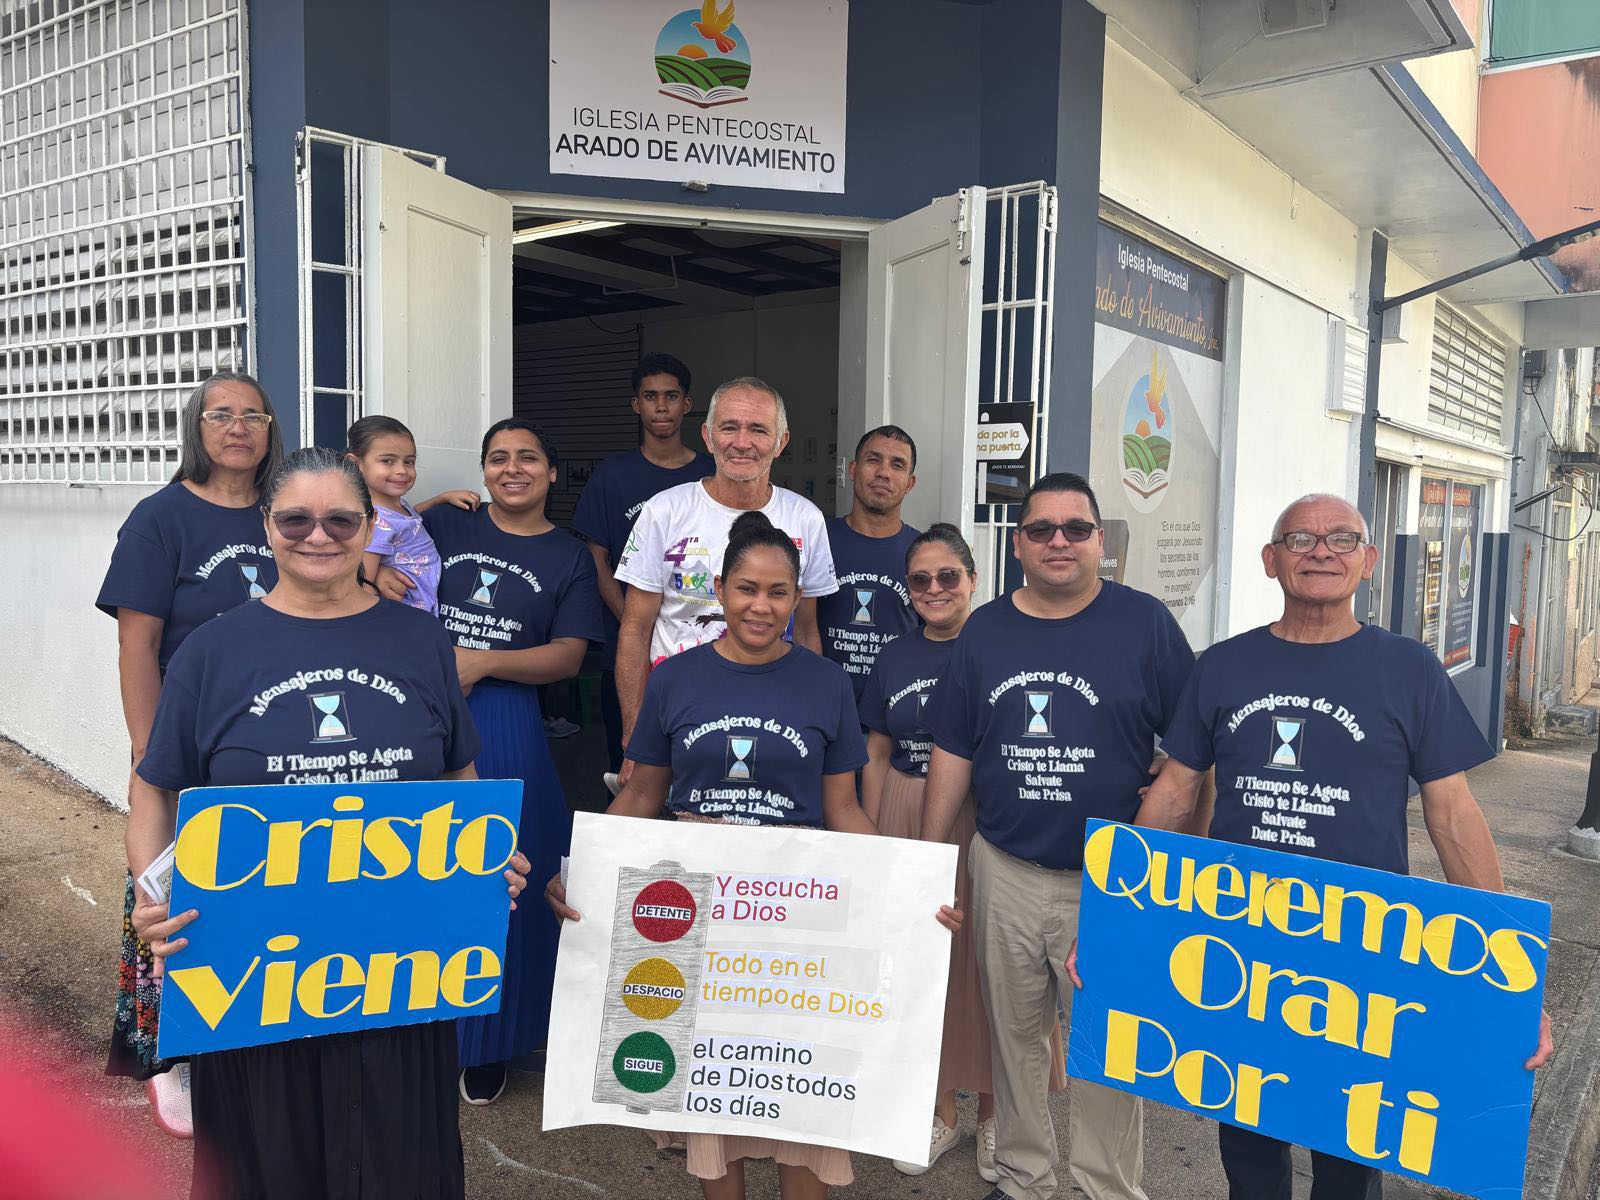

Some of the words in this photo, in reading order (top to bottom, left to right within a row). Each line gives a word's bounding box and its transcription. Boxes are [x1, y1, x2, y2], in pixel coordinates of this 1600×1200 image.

[573, 107, 660, 132] IGLESIA
[667, 114, 821, 145] PENTECOSTAL
[556, 133, 640, 158] ARADO
[648, 140, 678, 162] DE
[684, 142, 835, 173] AVIVAMIENTO
[1118, 243, 1145, 275] Iglesia
[1146, 256, 1189, 291] Pentecostal
[1119, 281, 1135, 320] de
[989, 442, 1023, 454] puerta.
[992, 431, 1008, 442] por
[1010, 429, 1020, 438] la
[195, 544, 256, 579] Mensajeros
[258, 545, 274, 558] de
[442, 552, 508, 570] Mensajeros
[508, 563, 522, 574] de
[522, 570, 542, 592] Dios
[880, 576, 893, 586] de
[893, 582, 911, 606] Dios
[440, 604, 447, 616] El
[449, 606, 482, 624] Tiempo
[484, 614, 496, 626] Se
[497, 617, 522, 632] Agota
[444, 619, 470, 634] Cristo
[471, 626, 480, 636] te
[482, 626, 512, 642] Llama
[458, 636, 490, 650] Salvate
[828, 627, 836, 637] El
[836, 628, 868, 643] Tiempo
[870, 632, 880, 642] Se
[834, 640, 858, 652] Cristo
[860, 644, 868, 653] te
[250, 668, 344, 716] Mensajeros
[347, 668, 368, 684] de
[370, 674, 406, 704] Dios
[988, 671, 1054, 706] Mensajeros
[1056, 672, 1072, 686] de
[1073, 677, 1100, 706] Dios
[1227, 693, 1310, 734] Mensajeros
[1312, 698, 1332, 714] de
[1332, 706, 1366, 742] Dios
[683, 715, 762, 750] Mensajeros
[764, 718, 781, 734] de
[782, 726, 808, 758] Dios
[267, 756, 284, 772] El
[287, 754, 346, 772] Tiempo
[350, 750, 368, 766] Se
[370, 747, 413, 766] Agota
[1001, 744, 1008, 756] El
[1008, 745, 1046, 760] Tiempo
[1048, 746, 1062, 758] Se
[1062, 746, 1096, 762] Agota
[1008, 759, 1034, 772] Cristo
[1036, 760, 1047, 772] te
[1048, 760, 1084, 772] Llama
[284, 773, 330, 784] Cristo
[333, 771, 348, 784] te
[352, 768, 399, 784] Llama
[1026, 774, 1062, 786] Salvate
[689, 788, 700, 802] El
[704, 788, 746, 803] Tiempo
[748, 787, 762, 800] Se
[764, 790, 795, 810] Agota
[1018, 788, 1041, 800] Date
[1042, 788, 1072, 802] Prisa
[1235, 776, 1244, 789] El
[1245, 776, 1290, 795] Tiempo
[1292, 780, 1308, 796] Se
[1310, 783, 1350, 803] Agota
[700, 802, 733, 813] Cristo
[736, 803, 746, 812] te
[748, 803, 784, 818] Llama
[1242, 792, 1274, 808] Cristo
[1277, 796, 1289, 810] te
[1292, 797, 1336, 816] Llama
[1262, 810, 1306, 830] Salvate
[174, 796, 518, 891] Cristo
[1252, 826, 1278, 842] Date
[1280, 830, 1316, 848] Prisa
[636, 906, 690, 920] DETENTE
[711, 904, 726, 920] a
[733, 900, 788, 922] Dios
[1084, 824, 1548, 993] Queremos
[706, 952, 763, 975] Todo
[770, 960, 798, 977] en
[804, 958, 826, 978] el
[623, 984, 684, 999] DESPACIO
[1169, 935, 1426, 1058] Orar
[828, 992, 884, 1019] Dios
[693, 1038, 714, 1059] el
[720, 1041, 813, 1065] camino
[625, 1060, 662, 1072] SIGUE
[690, 1066, 721, 1086] de
[686, 1092, 722, 1113] los
[729, 1095, 781, 1120] días
[1342, 1080, 1440, 1176] ti
